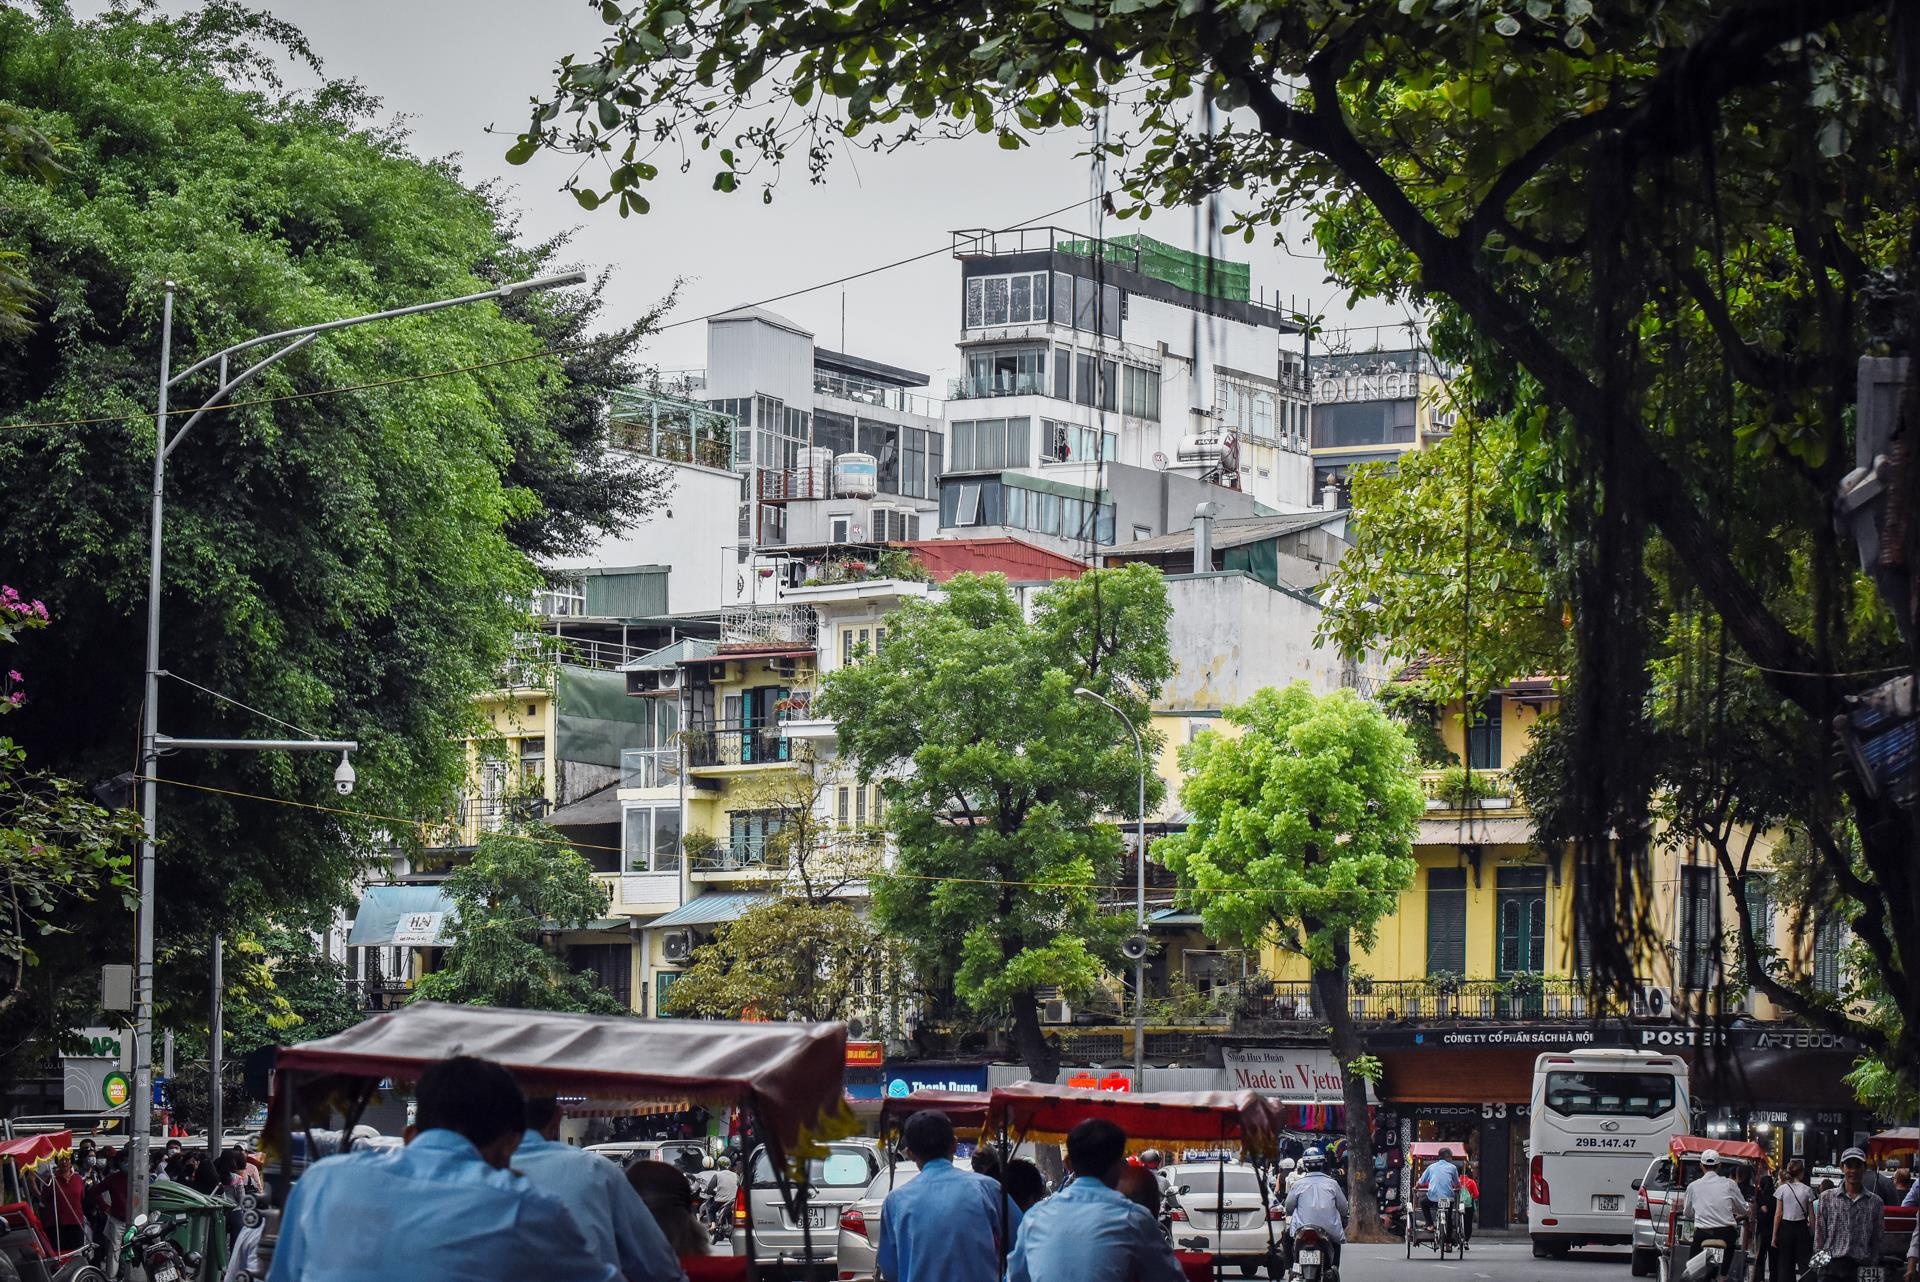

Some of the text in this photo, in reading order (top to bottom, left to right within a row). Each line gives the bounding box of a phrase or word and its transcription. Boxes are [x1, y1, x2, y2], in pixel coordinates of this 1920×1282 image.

[1444, 1032, 1471, 1043] CÔNG
[1473, 1034, 1486, 1043] TY
[1531, 1031, 1558, 1043] SÁCH
[1559, 1031, 1573, 1042] HÀ
[1575, 1031, 1593, 1044] NỘI
[1642, 1031, 1727, 1047] POSTER
[1246, 1053, 1262, 1062] Huy
[1234, 1064, 1343, 1090] Made in Vietn
[912, 1081, 946, 1093] Thanh
[1482, 1102, 1507, 1119] 53
[798, 1218, 824, 1227] 37.31
